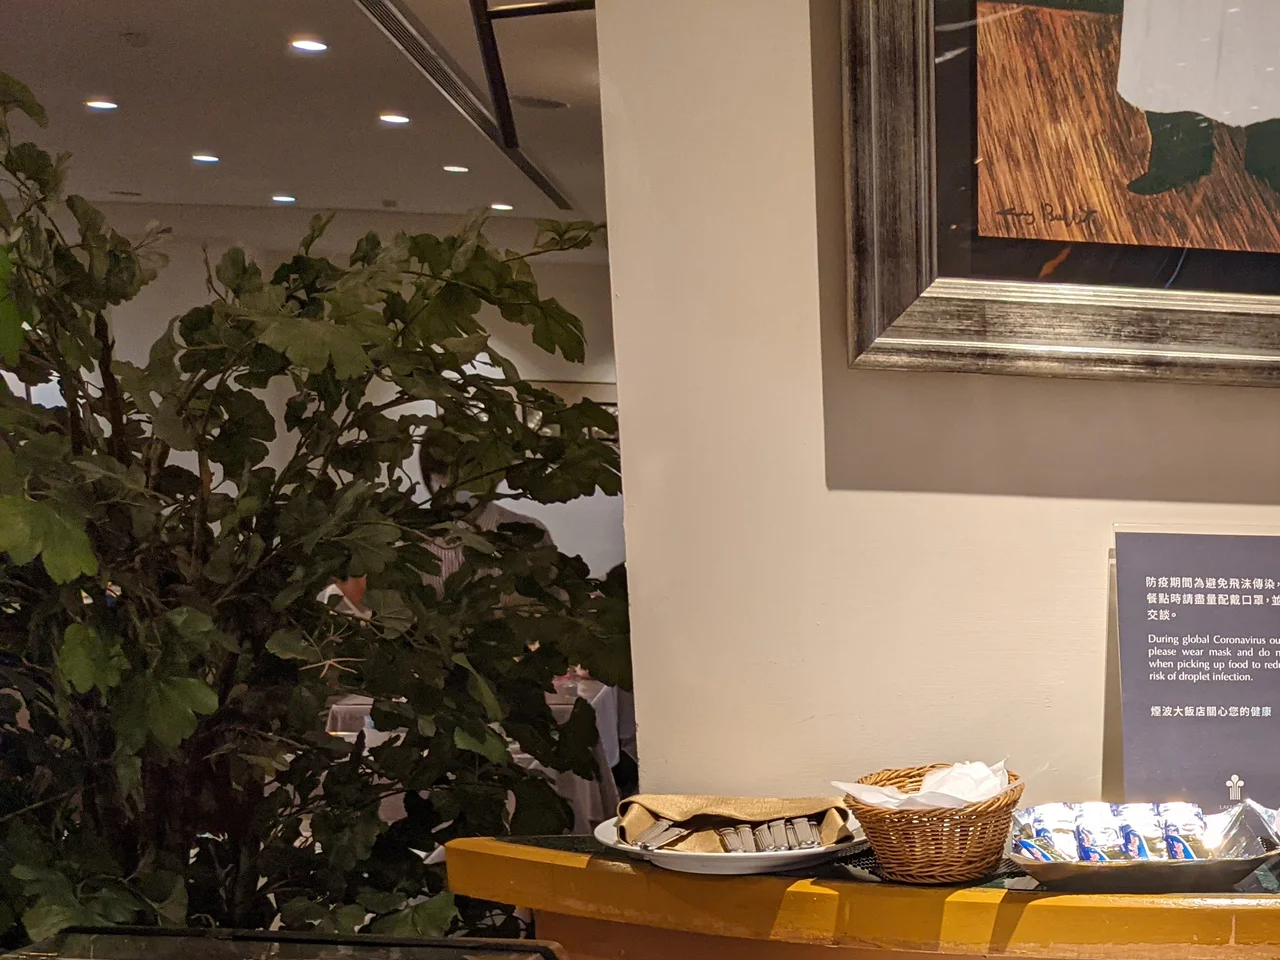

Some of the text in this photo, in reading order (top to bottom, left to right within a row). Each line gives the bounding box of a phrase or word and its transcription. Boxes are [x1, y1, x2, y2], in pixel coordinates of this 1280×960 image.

[1147, 609, 1177, 621] 交談。
[1148, 635, 1179, 646] During
[1182, 635, 1210, 646] global
[1213, 635, 1266, 645] Coronavirus
[1148, 647, 1177, 658] please
[1182, 649, 1204, 657] wear
[1208, 648, 1232, 657] mask
[1236, 648, 1254, 657] and
[1258, 648, 1271, 657] do
[1148, 659, 1174, 669] when
[1177, 659, 1210, 671] picking
[1213, 662, 1226, 671] up
[1228, 660, 1249, 669] food
[1252, 661, 1261, 669] to
[1149, 671, 1254, 683] risk of droplet infection.
[1150, 706, 1272, 718] 煙波大飯店關心您的健康
